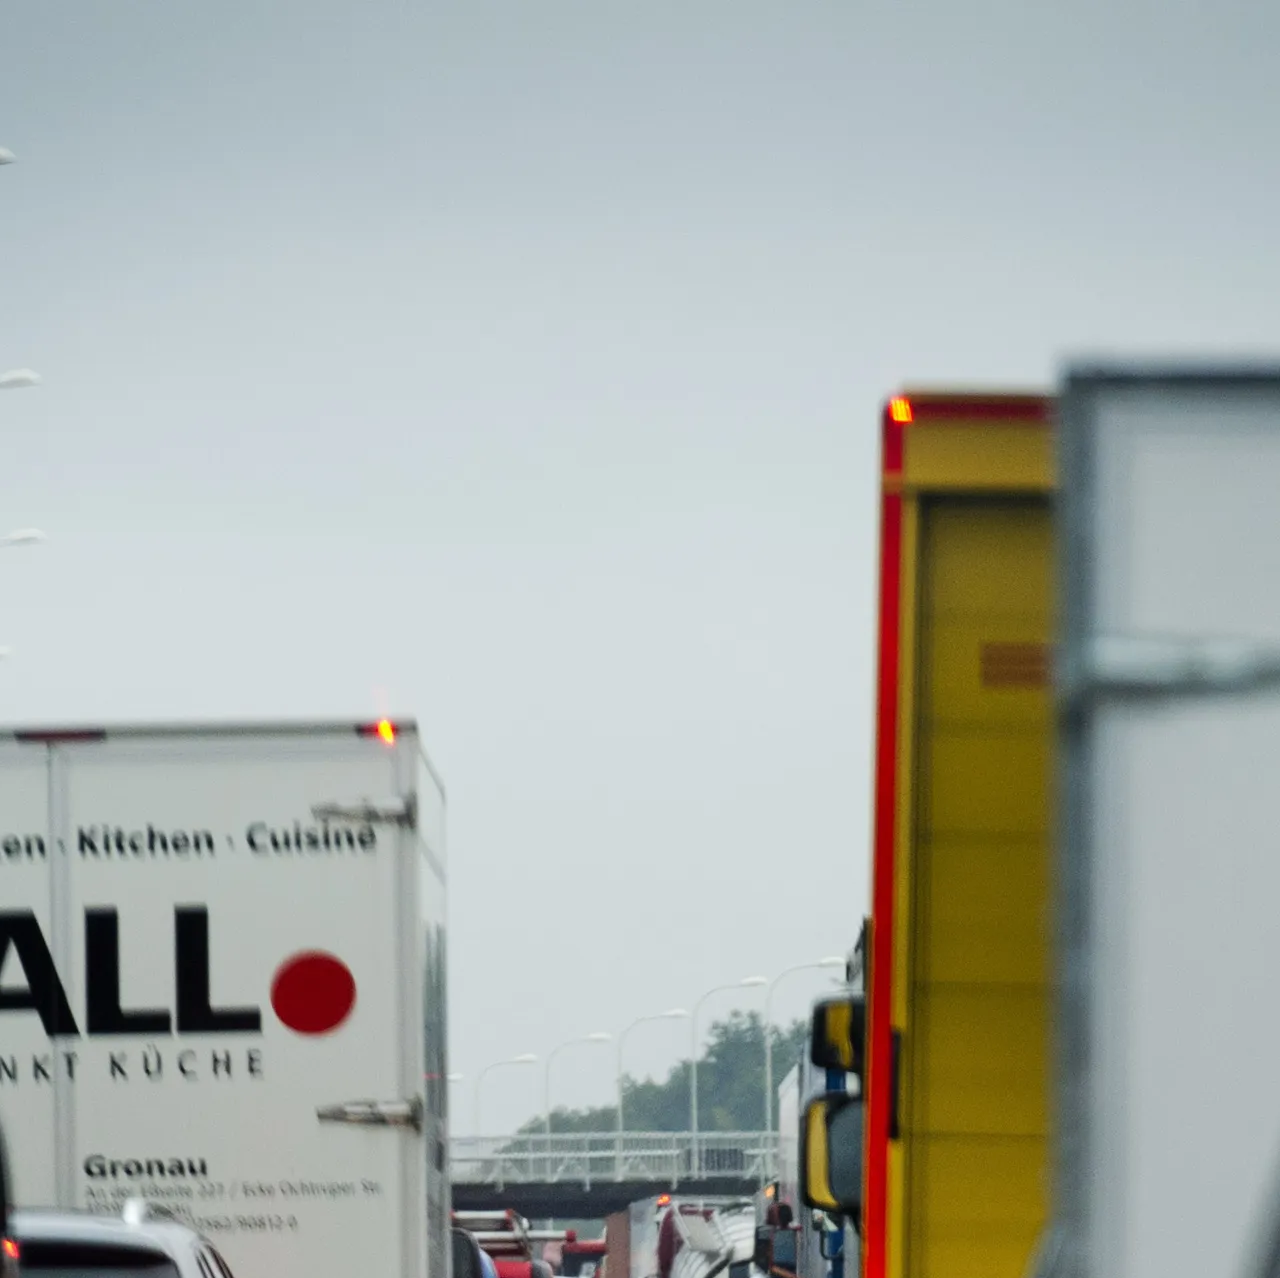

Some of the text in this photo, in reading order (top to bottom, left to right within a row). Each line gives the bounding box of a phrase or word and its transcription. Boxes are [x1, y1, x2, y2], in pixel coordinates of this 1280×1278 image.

[76, 823, 216, 859] Kitchen
[244, 820, 376, 855] Cuisine
[107, 1042, 265, 1080] KÜCHE
[82, 1153, 209, 1180] Gronau
